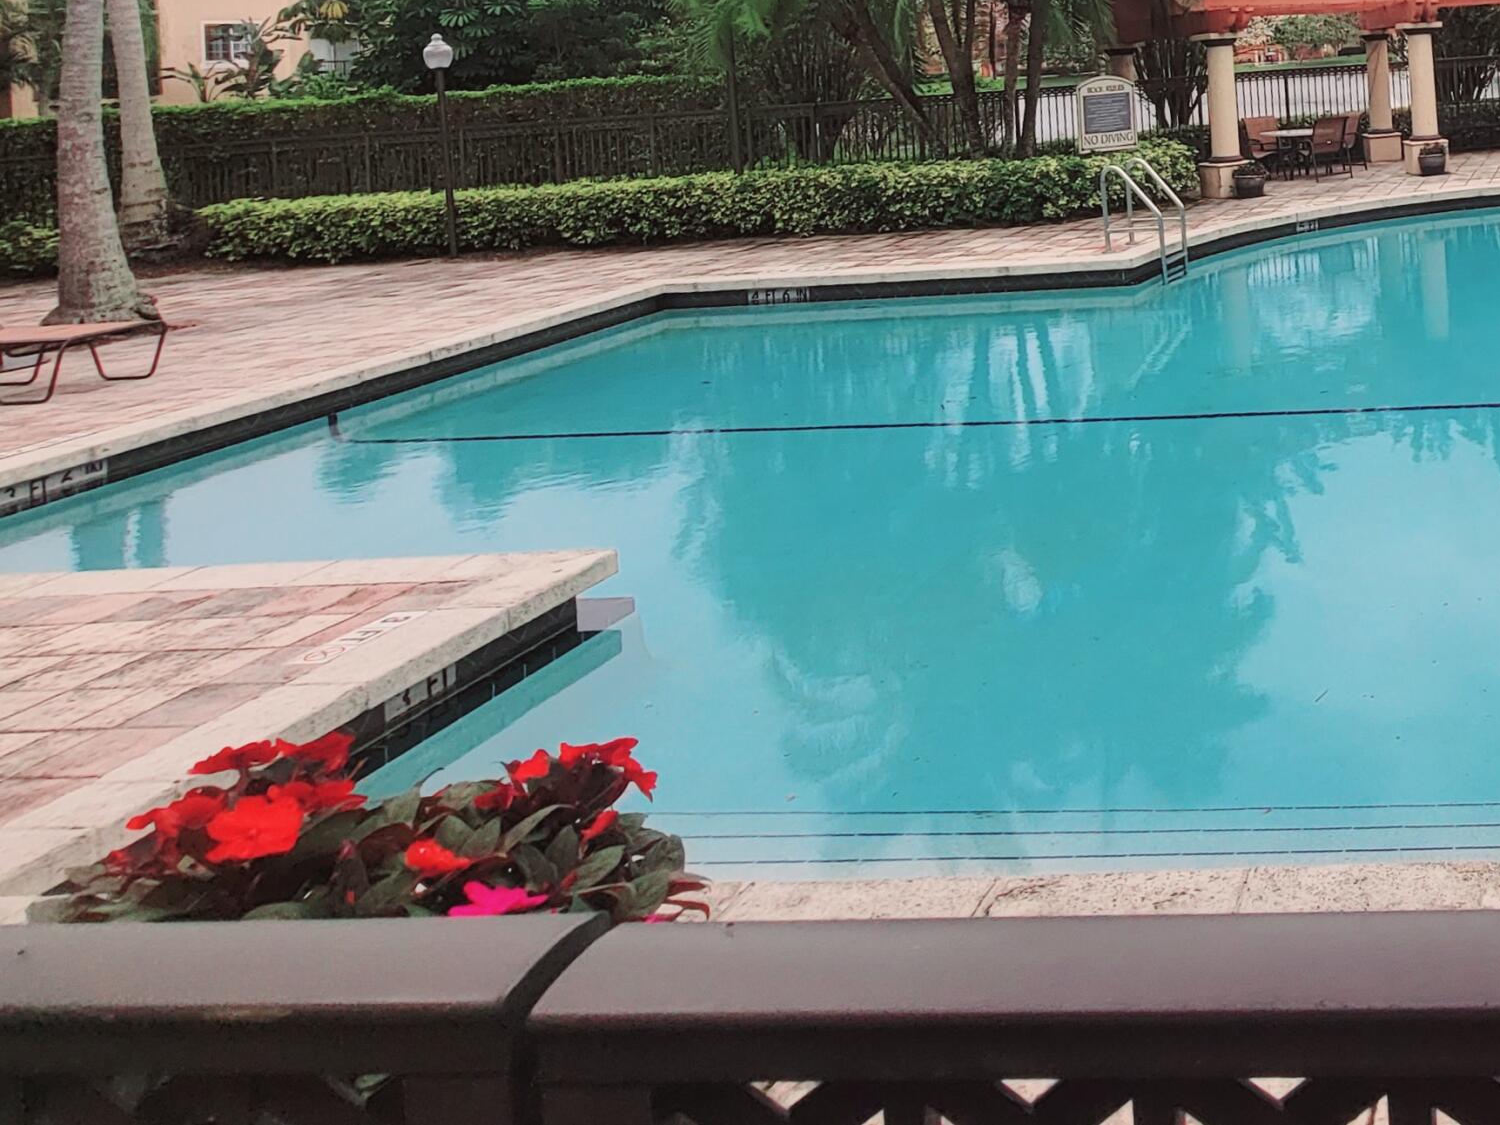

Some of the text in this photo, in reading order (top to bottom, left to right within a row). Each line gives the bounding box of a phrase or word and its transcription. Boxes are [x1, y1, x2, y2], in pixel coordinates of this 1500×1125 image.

[1084, 132, 1134, 145] NO DIVING
[751, 290, 760, 304] 4
[766, 289, 776, 304] FT
[782, 289, 791, 303] 6
[30, 476, 49, 505] FT
[425, 667, 448, 696] FT
